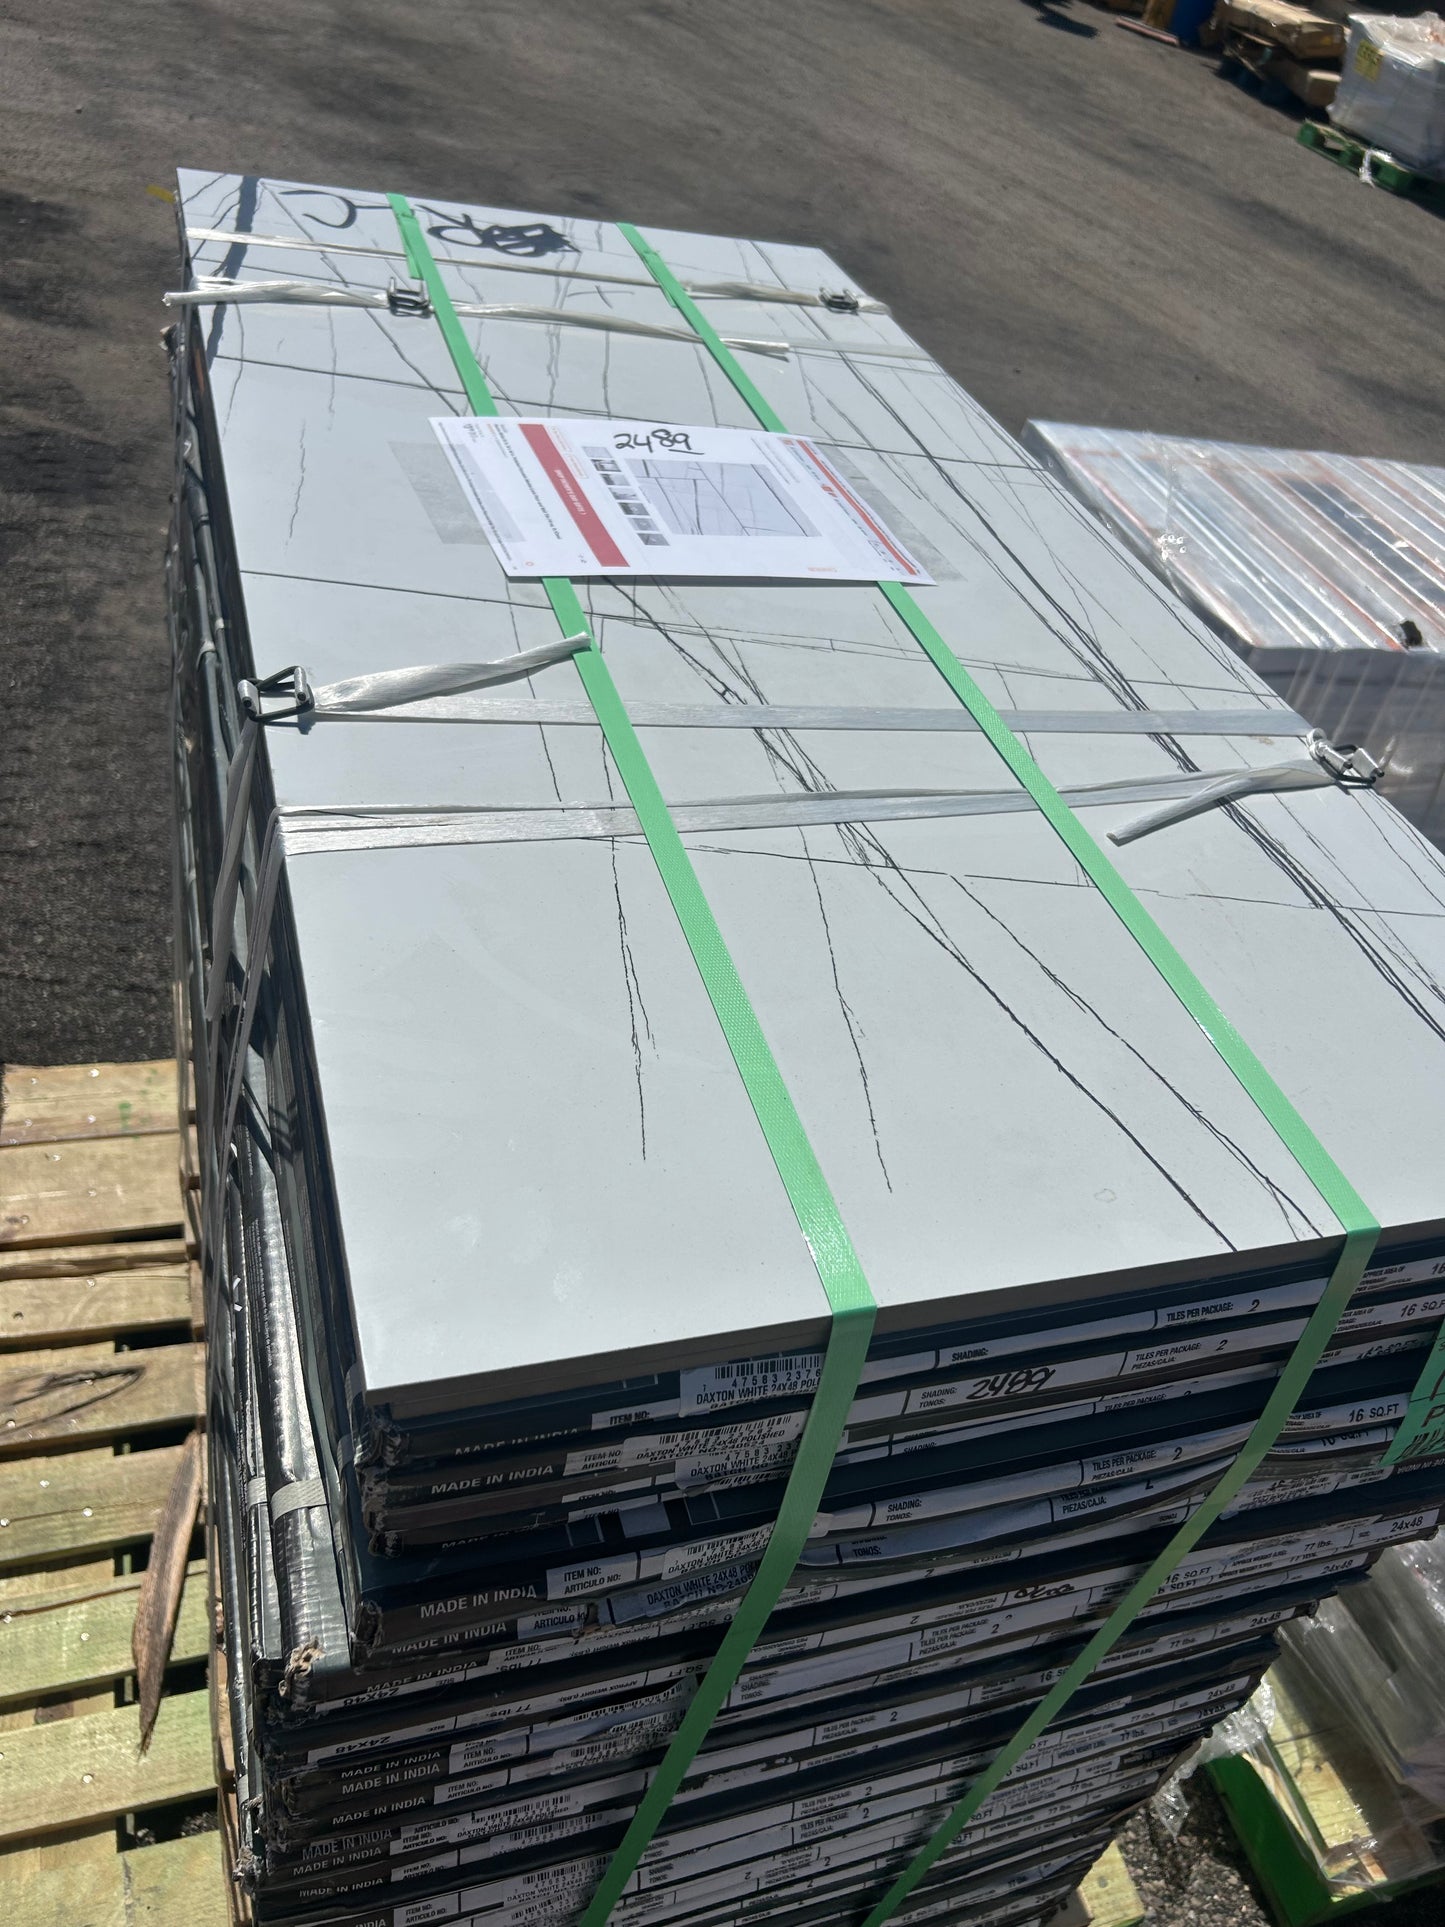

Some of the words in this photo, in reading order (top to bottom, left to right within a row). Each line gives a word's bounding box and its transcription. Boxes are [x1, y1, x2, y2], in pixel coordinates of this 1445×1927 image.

[612, 428, 700, 454] 2489
[1166, 1309, 1185, 1322] TILES
[1187, 1307, 1200, 1319] PER
[1201, 1302, 1234, 1316] PACKAGE:
[1248, 1299, 1260, 1313] 2
[1401, 1304, 1417, 1317] 16
[1135, 1350, 1154, 1361] TILES
[1156, 1348, 1169, 1358] PER
[1170, 1343, 1202, 1355] PACKAGE:
[1216, 1339, 1228, 1351] 2
[966, 1367, 1056, 1400] 2489
[696, 1389, 735, 1405] DAXTON
[739, 1385, 769, 1400] WHITE
[771, 1381, 797, 1393] 24X48
[921, 1386, 958, 1399] SHADING:
[919, 1398, 946, 1408] TONOS:
[609, 1412, 633, 1425] ITEM
[1349, 1408, 1364, 1423] 16
[1369, 1403, 1400, 1419] SQ.FT
[636, 1449, 676, 1459] DAXTON
[678, 1443, 707, 1455] WHITE
[740, 1429, 785, 1443] POLISHED
[584, 1451, 608, 1462] ITEM
[690, 1463, 727, 1477] DAXTON
[731, 1457, 759, 1471] WHITE
[762, 1451, 788, 1465] 24X48
[1093, 1459, 1111, 1472] TILES
[1112, 1457, 1125, 1469] PER
[1173, 1447, 1183, 1460] 2
[431, 1477, 482, 1494] MADE
[486, 1473, 504, 1486] IN
[508, 1465, 555, 1482] INDIA
[887, 1499, 922, 1513] SHADING:
[1062, 1496, 1107, 1514] PIEZAS/CAJA:
[885, 1512, 913, 1522] TONOS:
[1390, 1516, 1424, 1533] 24x48
[852, 1546, 881, 1557] TONOS:
[668, 1558, 704, 1573] DAXTON
[706, 1552, 734, 1565] WHITE
[563, 1568, 585, 1582] ITEM
[587, 1566, 602, 1577] NO:
[564, 1578, 605, 1595] ARTICULO
[607, 1573, 621, 1583] NO:
[647, 1587, 682, 1605] DAXTON
[684, 1576, 711, 1594] WHITE
[713, 1567, 738, 1583] 24X48
[420, 1597, 468, 1619] MADE
[473, 1592, 489, 1606] IN
[494, 1584, 537, 1601] INDIA
[534, 1614, 575, 1630] ARTICULO
[990, 1623, 1000, 1635] 2
[444, 1633, 459, 1644] IN
[464, 1622, 507, 1640] INDIA
[505, 1645, 526, 1656] ITEM
[527, 1643, 541, 1653] NO:
[367, 1676, 412, 1693] MADE
[416, 1671, 432, 1681] IN
[438, 1661, 478, 1676] INDIA
[890, 1711, 898, 1722] 2
[463, 1749, 482, 1760] ITEM
[463, 1755, 499, 1768] ARTICULO
[340, 1762, 380, 1778] MADE
[386, 1759, 399, 1769] IN
[404, 1751, 441, 1766] INDIA
[341, 1776, 382, 1795] MADE
[386, 1772, 400, 1785] IN
[404, 1763, 440, 1781] INDIA
[448, 1782, 465, 1793] ITEM
[466, 1780, 479, 1788] NO:
[447, 1787, 481, 1799] ARTICULO
[864, 1786, 873, 1796] 2
[332, 1809, 371, 1825] MADE
[374, 1805, 387, 1816] IN
[391, 1796, 426, 1812] INDIA
[862, 1807, 870, 1819] 2
[402, 1833, 419, 1843] ITEM
[457, 1827, 486, 1838] DAXTON
[302, 1839, 338, 1861] MADE
[342, 1835, 356, 1849] IN
[358, 1828, 393, 1846] INDIA
[402, 1838, 434, 1850] ARTICULO
[293, 1858, 329, 1876] MADE
[333, 1854, 345, 1866] IN
[349, 1847, 382, 1863] INDIA
[824, 1855, 831, 1866] 2
[300, 1886, 333, 1897] MADE
[336, 1884, 349, 1893] IN
[352, 1877, 384, 1891] INDIA
[507, 1890, 536, 1902] DAXTON
[538, 1884, 560, 1896] WHITE
[405, 1906, 422, 1916] ITEM
